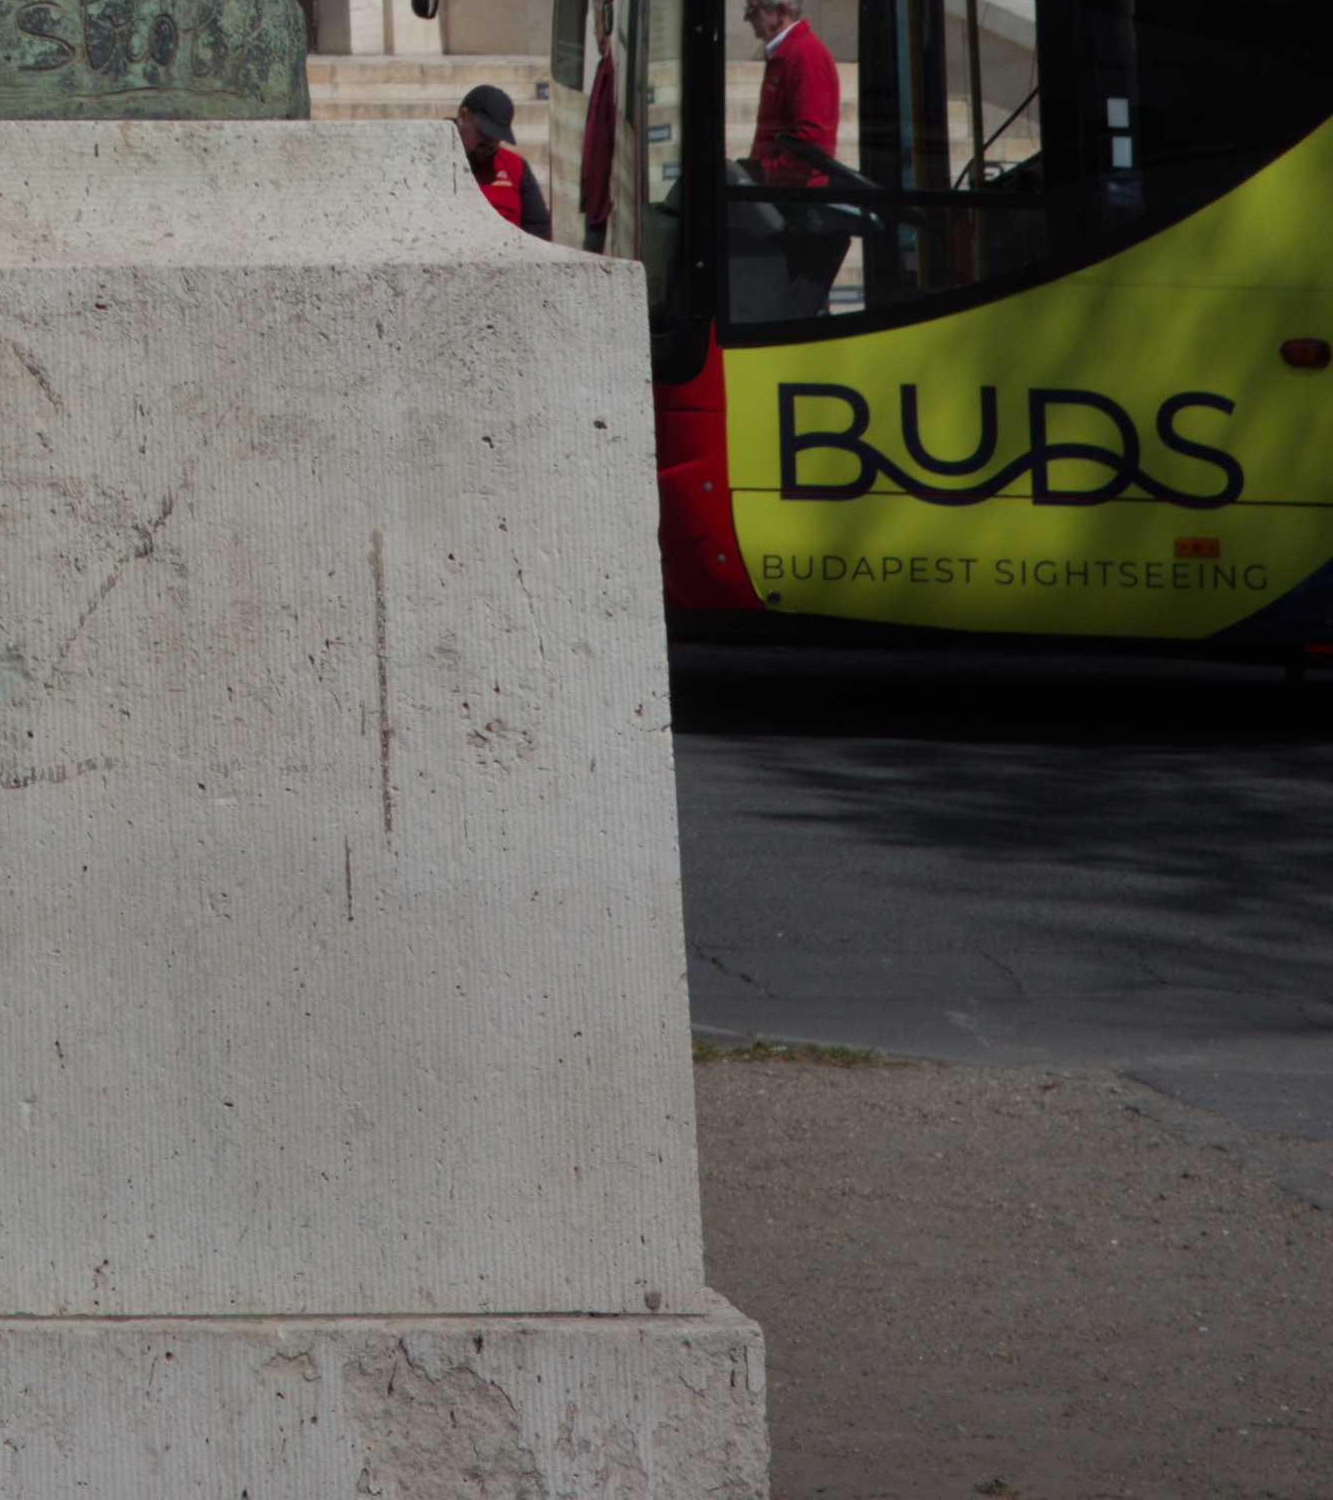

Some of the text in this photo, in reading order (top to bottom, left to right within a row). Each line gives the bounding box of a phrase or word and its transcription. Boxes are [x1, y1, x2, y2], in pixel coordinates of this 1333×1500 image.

[778, 382, 1245, 508] BUDS
[762, 553, 1271, 592] BUDAPEST SIGHTSEEING
